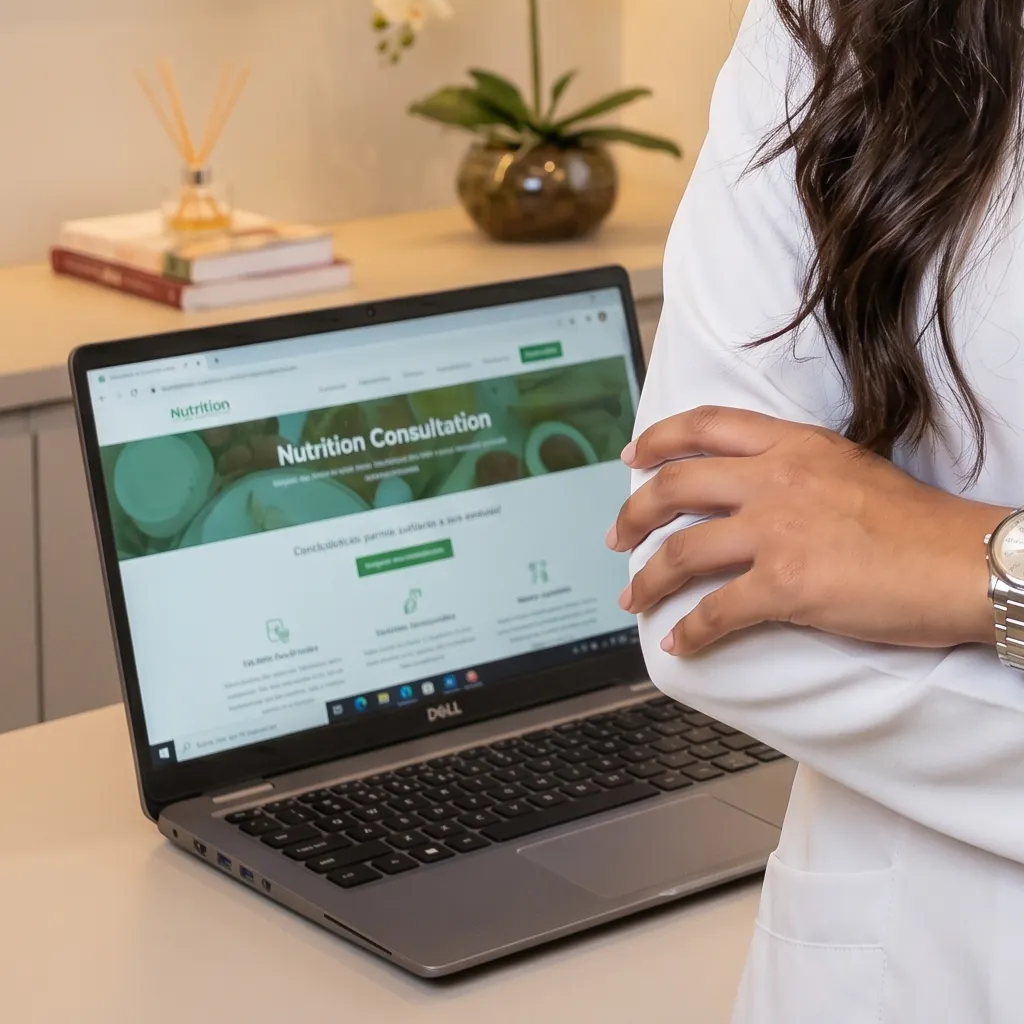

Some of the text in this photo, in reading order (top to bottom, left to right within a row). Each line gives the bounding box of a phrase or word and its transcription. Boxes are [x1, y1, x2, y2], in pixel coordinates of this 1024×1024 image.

[170, 398, 230, 419] Nutrition
[277, 433, 366, 466] Nutrition
[369, 411, 493, 449] Consultation
[426, 700, 463, 723] DELL
